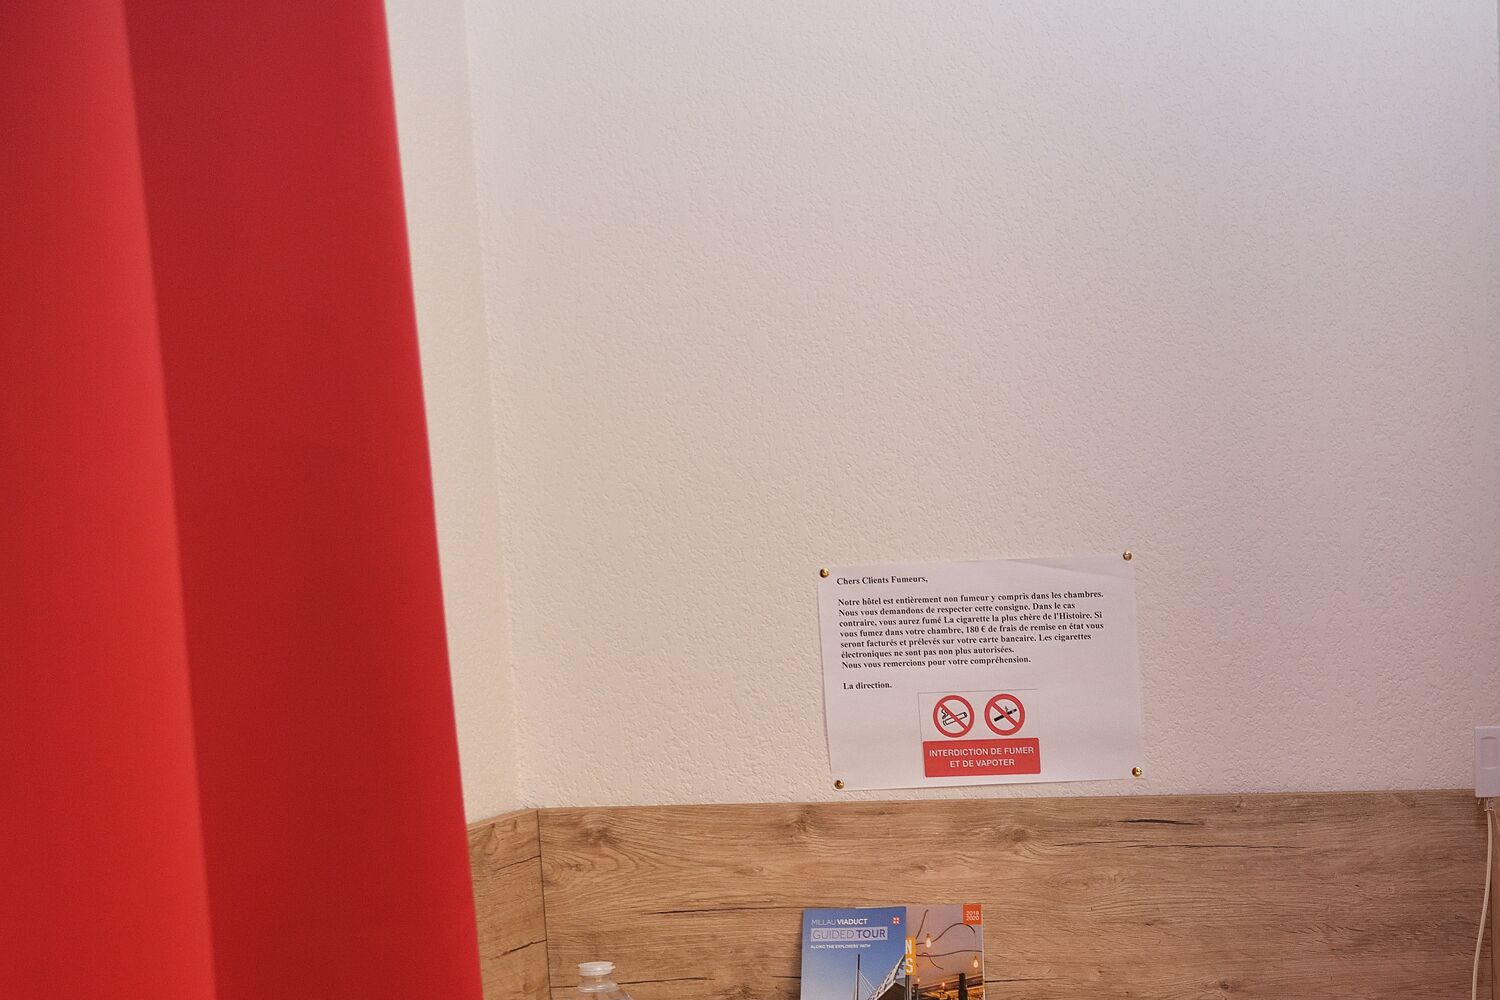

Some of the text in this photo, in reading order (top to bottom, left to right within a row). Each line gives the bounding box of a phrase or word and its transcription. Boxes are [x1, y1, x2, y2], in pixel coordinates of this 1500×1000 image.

[836, 575, 928, 585] Chers Clients Fumeurs,
[838, 598, 860, 606] Notre
[862, 597, 881, 605] hôtel
[895, 596, 941, 604] entièrement
[960, 594, 989, 602] fumeur
[990, 595, 996, 603] y
[997, 592, 1029, 602] compris
[1030, 592, 1049, 600] dans
[1051, 591, 1062, 599] les
[1063, 590, 1104, 599] chambres.
[838, 609, 858, 617] Nous
[879, 606, 924, 615] demandons
[937, 606, 973, 615] respecter
[994, 603, 1030, 612] consigne.
[1032, 602, 1052, 610] Dans
[839, 618, 877, 627] contraire,
[922, 616, 942, 624] fumé
[956, 615, 990, 625] cigarette
[991, 614, 999, 622] la
[1001, 614, 1018, 623] plus
[1019, 613, 1041, 621] chère
[1042, 612, 1052, 620] de
[1053, 611, 1092, 620] l'Histoire.
[1094, 610, 1102, 619] Si
[859, 629, 883, 637] fumez
[885, 628, 903, 636] dans
[927, 626, 964, 635] chambre,
[966, 625, 979, 633] 180
[980, 625, 986, 633] €
[999, 624, 1017, 632] frais
[1030, 623, 1056, 631] remise
[1068, 622, 1084, 630] état
[866, 638, 897, 647] facturés
[908, 637, 940, 648] prélevés
[1000, 634, 1036, 642] bancaire.
[1054, 633, 1091, 642] cigarettes
[841, 650, 892, 659] électroniques
[923, 649, 937, 657] pas
[955, 647, 972, 656] plus
[973, 645, 1014, 654] autorisées.
[841, 661, 862, 669] Nous
[883, 659, 926, 667] remercions
[927, 660, 946, 668] pour
[970, 655, 1031, 666] compréhension.
[843, 681, 892, 690] La direction.
[929, 748, 988, 757] INTERDICTION
[1004, 746, 1034, 754] FUMER
[949, 760, 960, 768] ET
[976, 758, 1015, 767] VAPOTER
[812, 928, 886, 940] GUIDED TOUR
